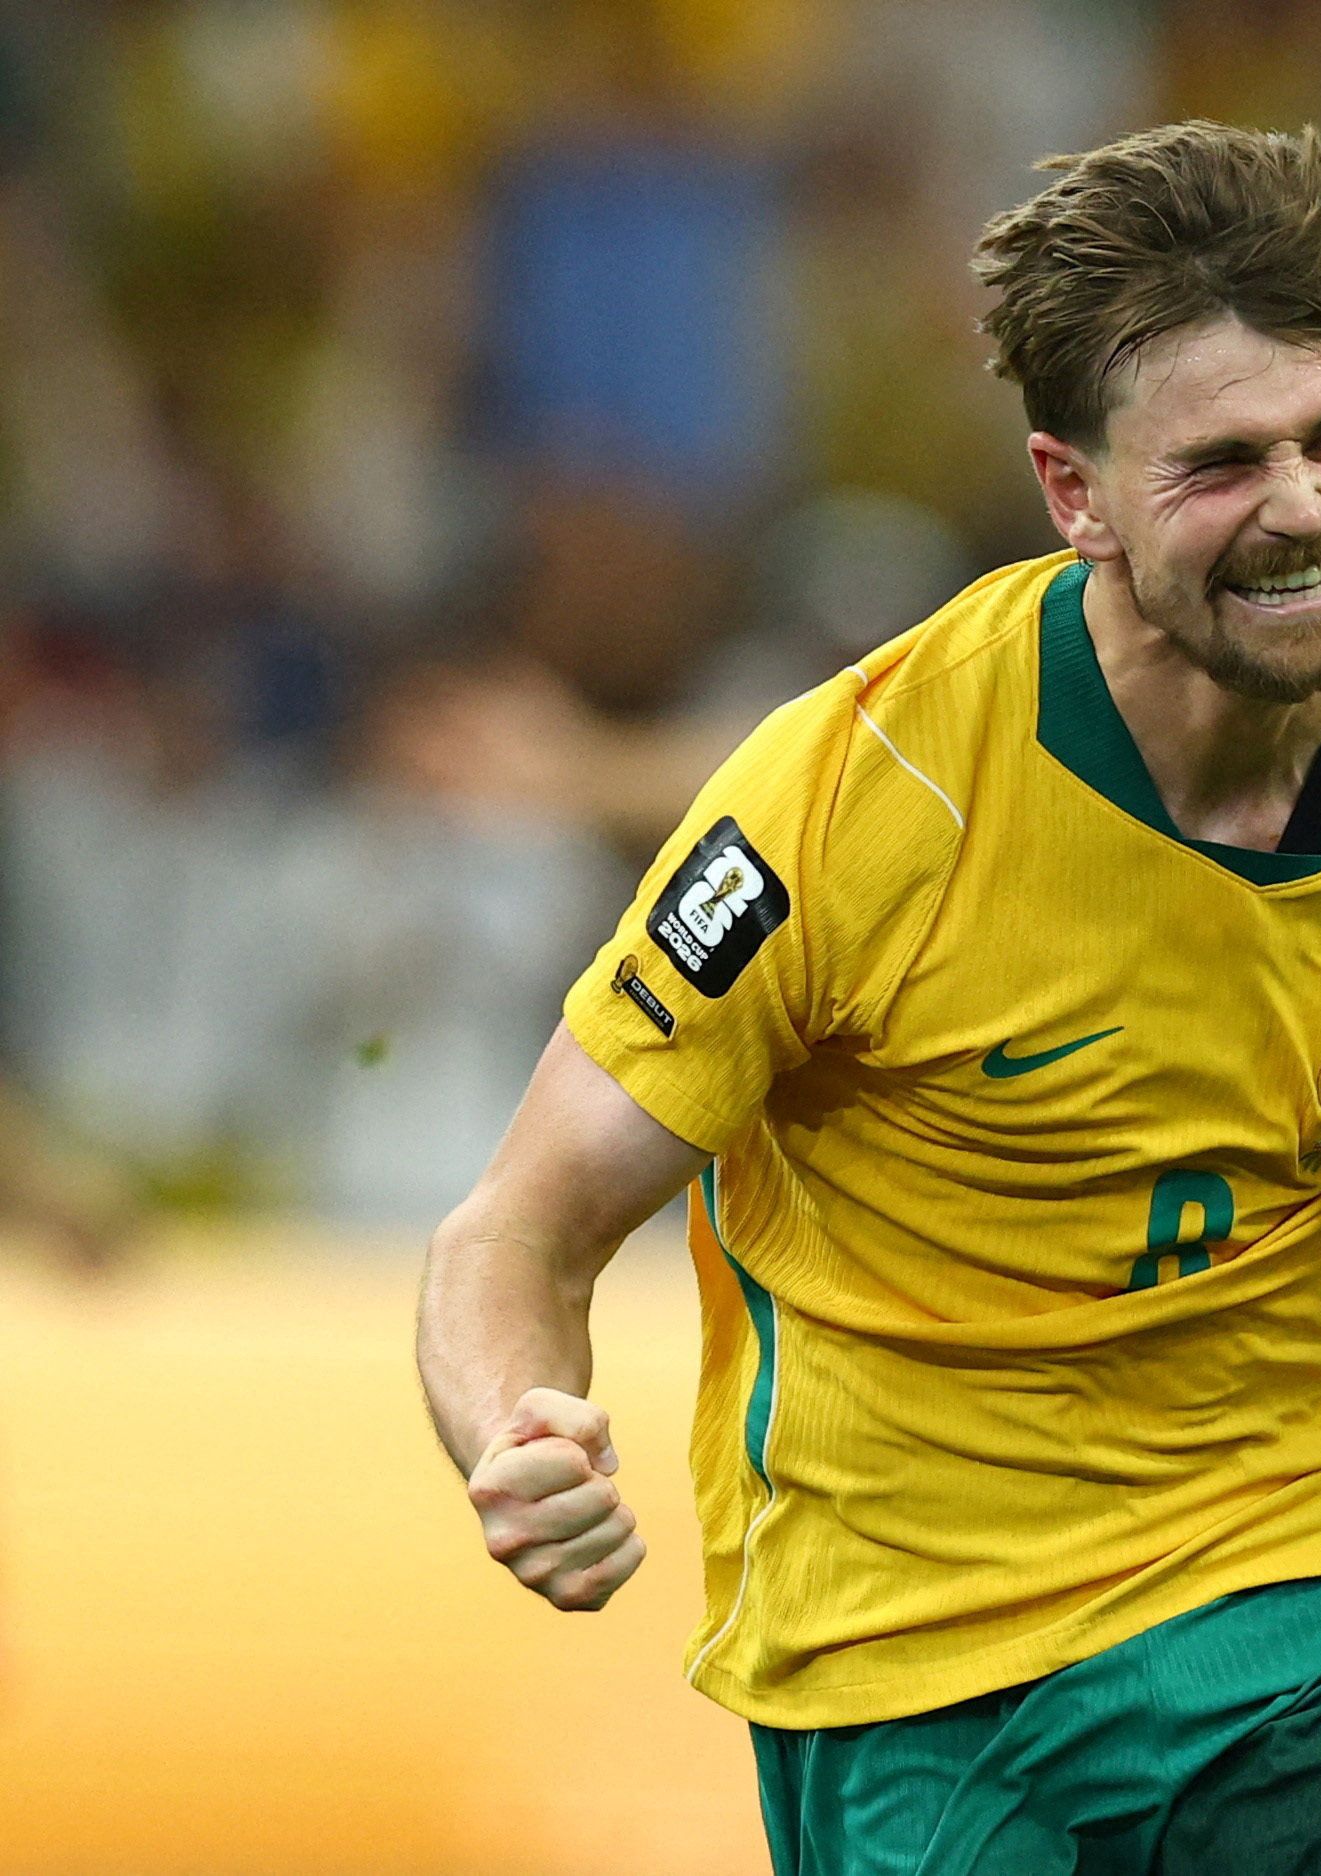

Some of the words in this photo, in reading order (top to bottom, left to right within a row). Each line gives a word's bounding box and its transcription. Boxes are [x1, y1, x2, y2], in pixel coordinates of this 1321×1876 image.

[667, 911, 693, 945] WORLD
[691, 942, 709, 960] CUP
[690, 909, 708, 934] FIFA
[657, 920, 703, 972] 2026
[631, 979, 672, 1024] DEBUT
